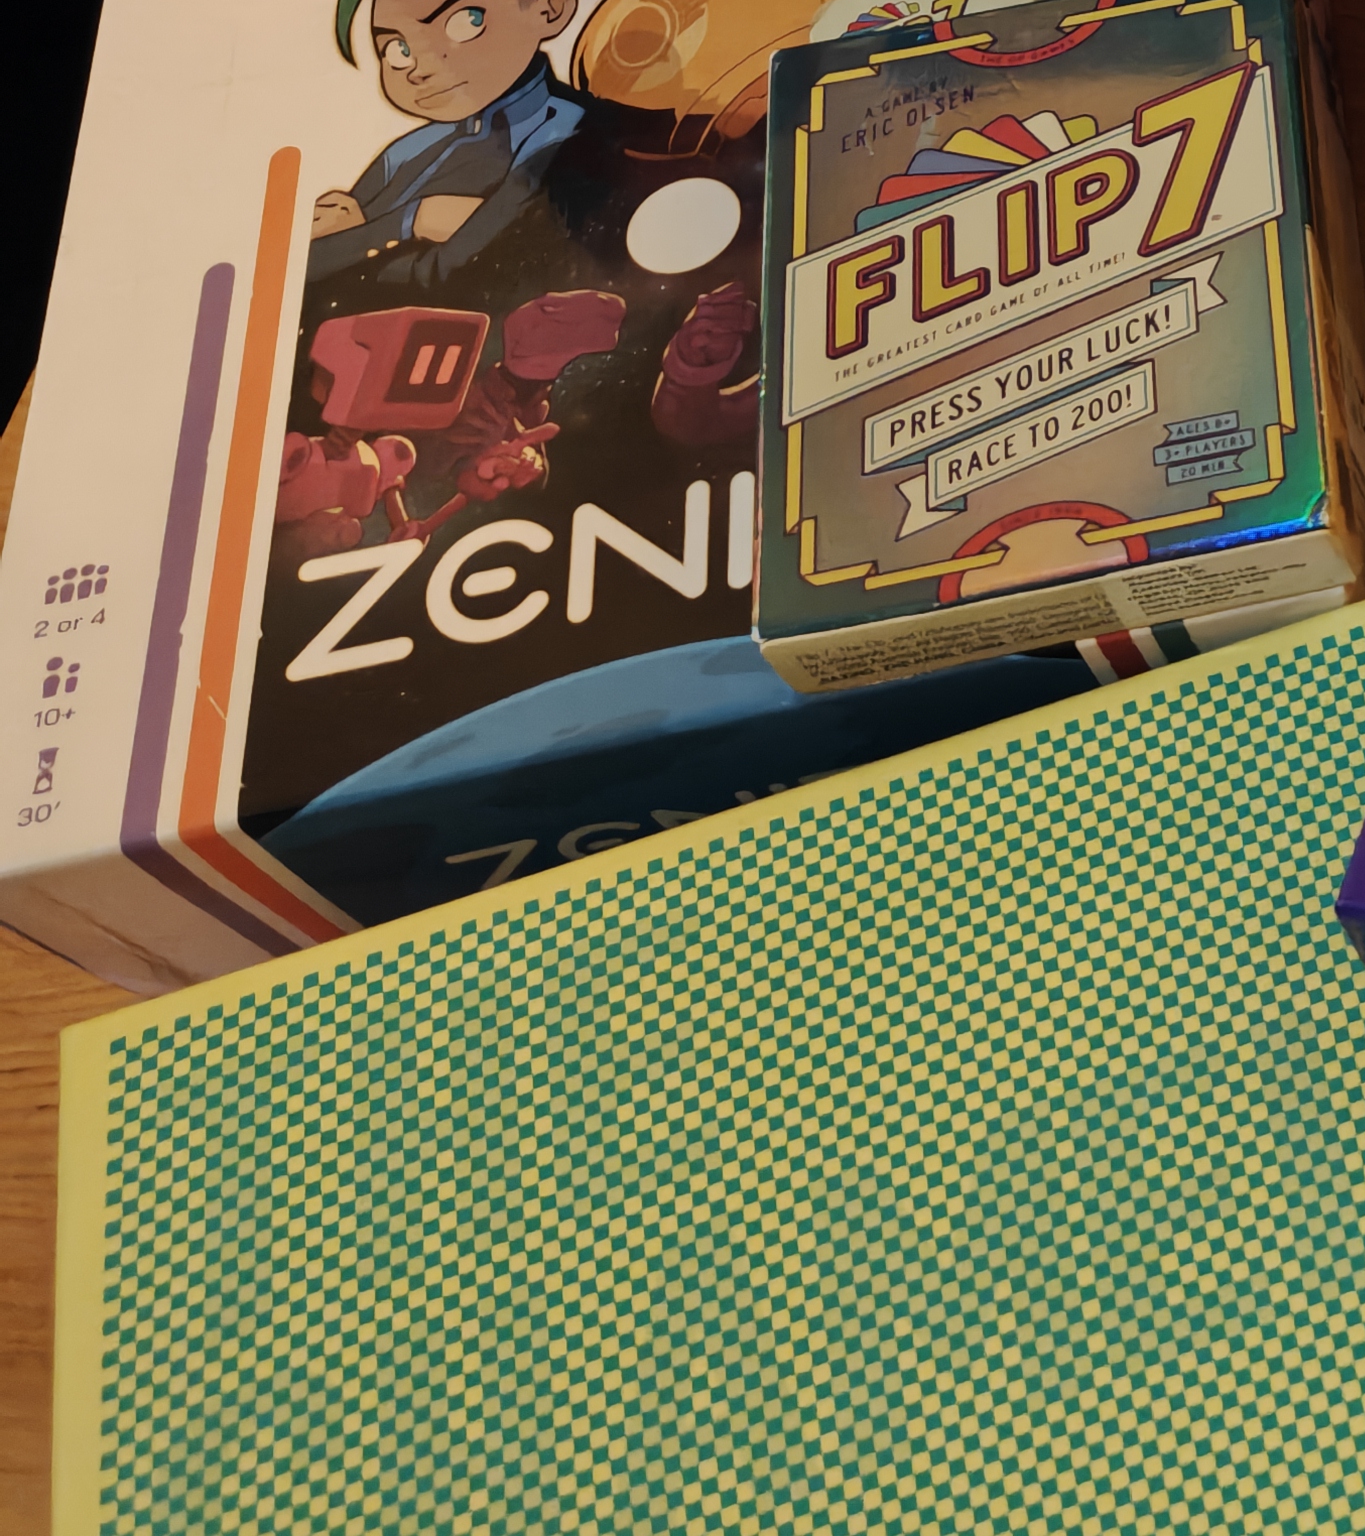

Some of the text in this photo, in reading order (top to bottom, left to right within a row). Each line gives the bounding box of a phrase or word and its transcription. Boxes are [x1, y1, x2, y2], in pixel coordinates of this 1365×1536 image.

[841, 85, 975, 154] ERIC OLSEN
[826, 62, 1255, 358] FLIP 7
[834, 272, 1082, 382] THE GREATEST CARD GAME ALL
[889, 304, 1172, 449] PRESS YOUR LUCK!
[948, 384, 1133, 485] RACE TO 200!
[1185, 434, 1246, 457] PLAYERS
[34, 608, 107, 639] 2 or 4
[286, 471, 756, 683] ZENI
[33, 706, 77, 729] 10+
